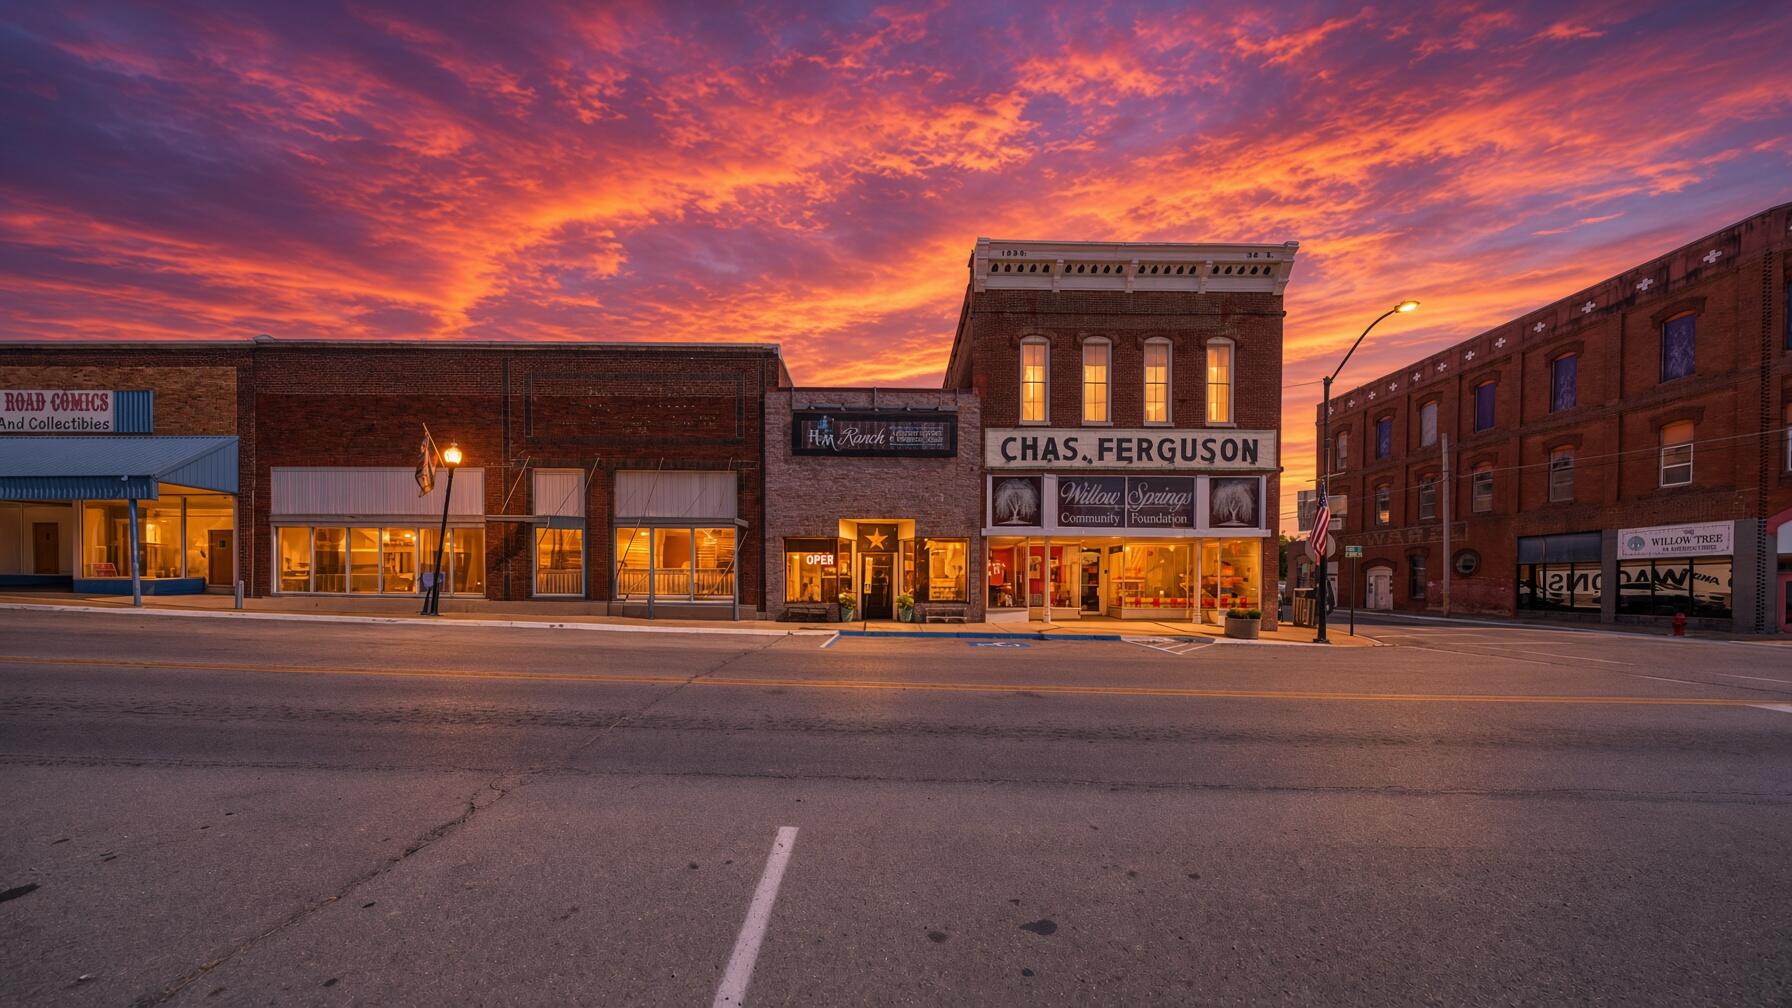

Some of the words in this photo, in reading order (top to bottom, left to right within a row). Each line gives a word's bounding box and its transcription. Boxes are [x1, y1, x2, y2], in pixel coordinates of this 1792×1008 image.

[4, 392, 46, 411] ROAD
[51, 391, 109, 411] COMICS
[0, 417, 24, 429] And
[837, 426, 886, 447] Ranch
[1098, 437, 1258, 463] FERGUSON
[1061, 481, 1120, 505] Willow
[1128, 482, 1192, 512] Springs
[1061, 512, 1120, 526] Community
[1651, 535, 1692, 546] WILLOW
[1693, 533, 1723, 544] TREE
